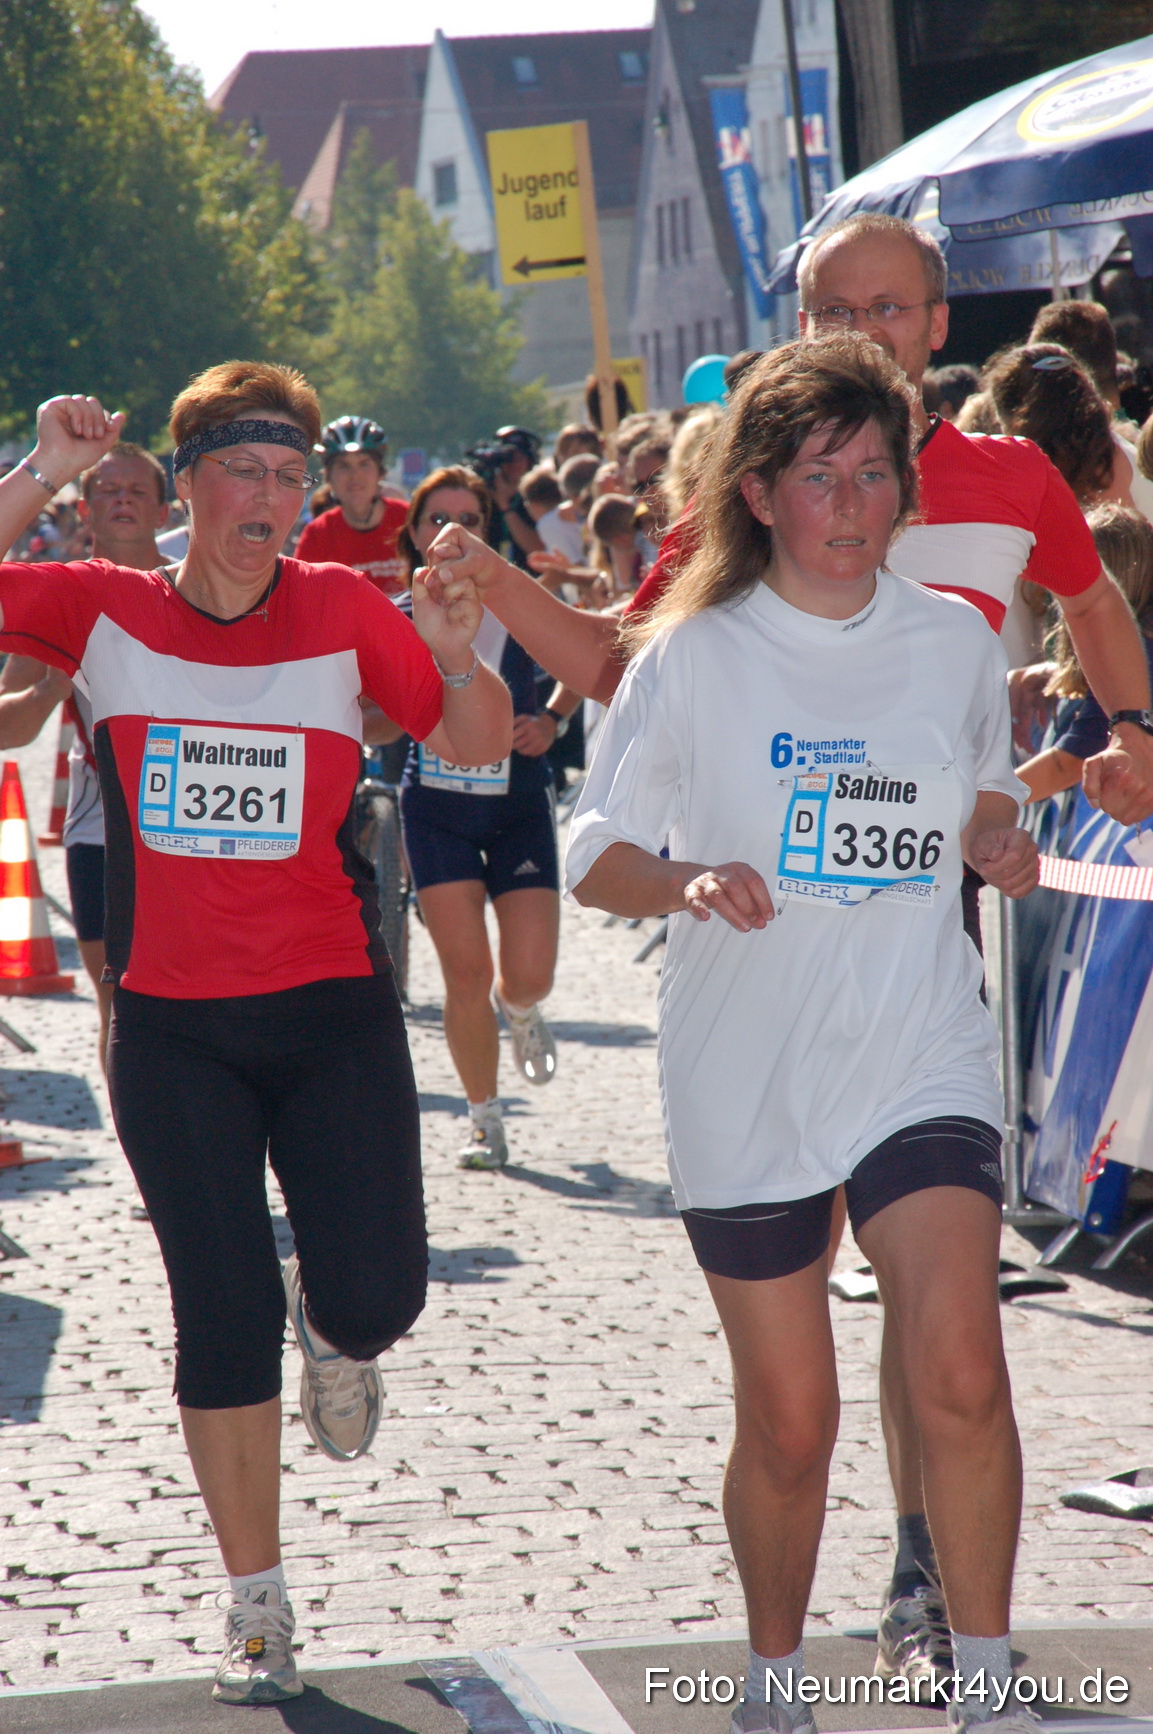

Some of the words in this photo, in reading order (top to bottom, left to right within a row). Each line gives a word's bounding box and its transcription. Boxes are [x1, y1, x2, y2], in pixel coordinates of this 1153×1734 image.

[497, 167, 579, 198] Jugend
[524, 195, 567, 221] lauf
[183, 740, 287, 768] Waltraud
[797, 738, 866, 751] Neumarkter
[814, 751, 866, 764] Stadtlauf
[150, 773, 166, 792] D
[835, 773, 917, 804] Sabine
[183, 783, 287, 824] 3261
[795, 810, 814, 833] D
[143, 832, 199, 849] BOCK
[237, 839, 296, 851] PFLEIDERER
[832, 823, 944, 871] 3366
[778, 879, 849, 899] BOCK
